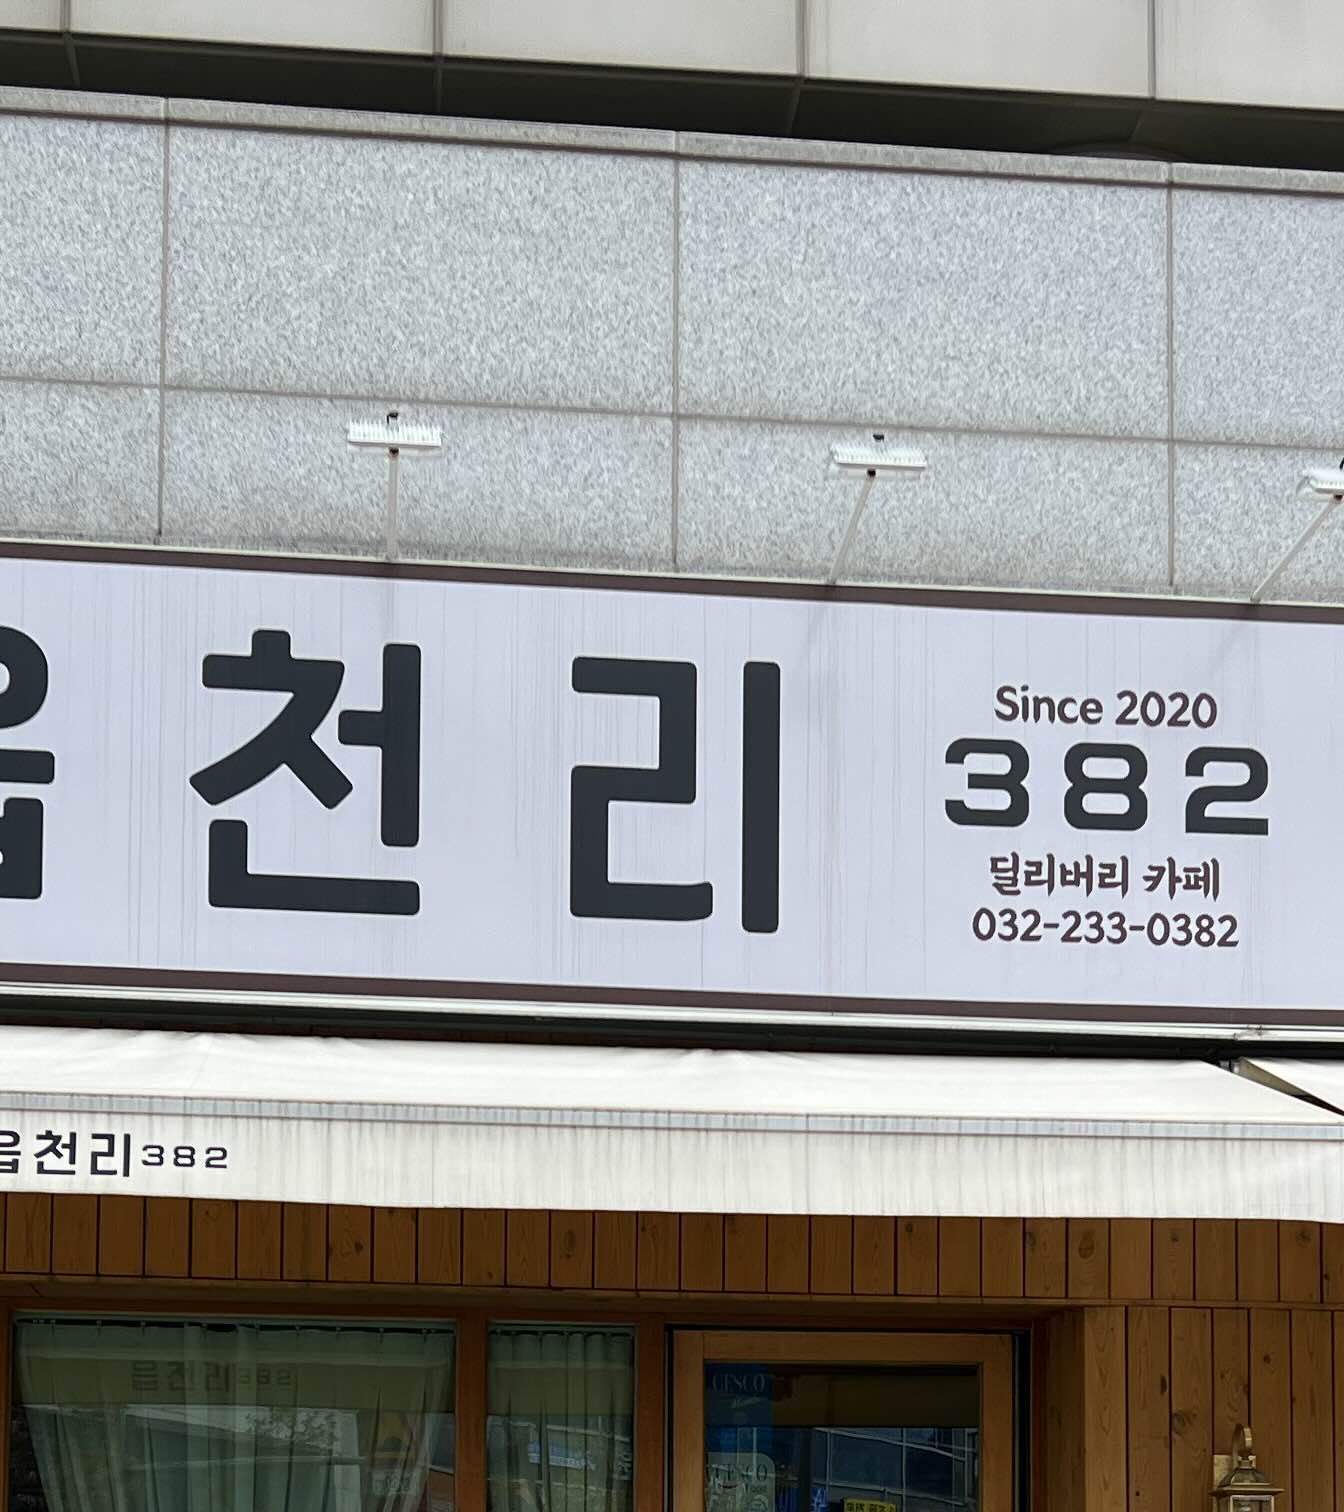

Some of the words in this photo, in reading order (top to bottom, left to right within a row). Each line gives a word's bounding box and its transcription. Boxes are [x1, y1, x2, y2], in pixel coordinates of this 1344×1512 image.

[994, 684, 1104, 726] Since
[1115, 689, 1218, 729] 2020
[944, 736, 1270, 837] 382
[989, 851, 1131, 900] 딜리버리
[1142, 856, 1221, 902] 카페
[972, 906, 1240, 948] 032-233-0382
